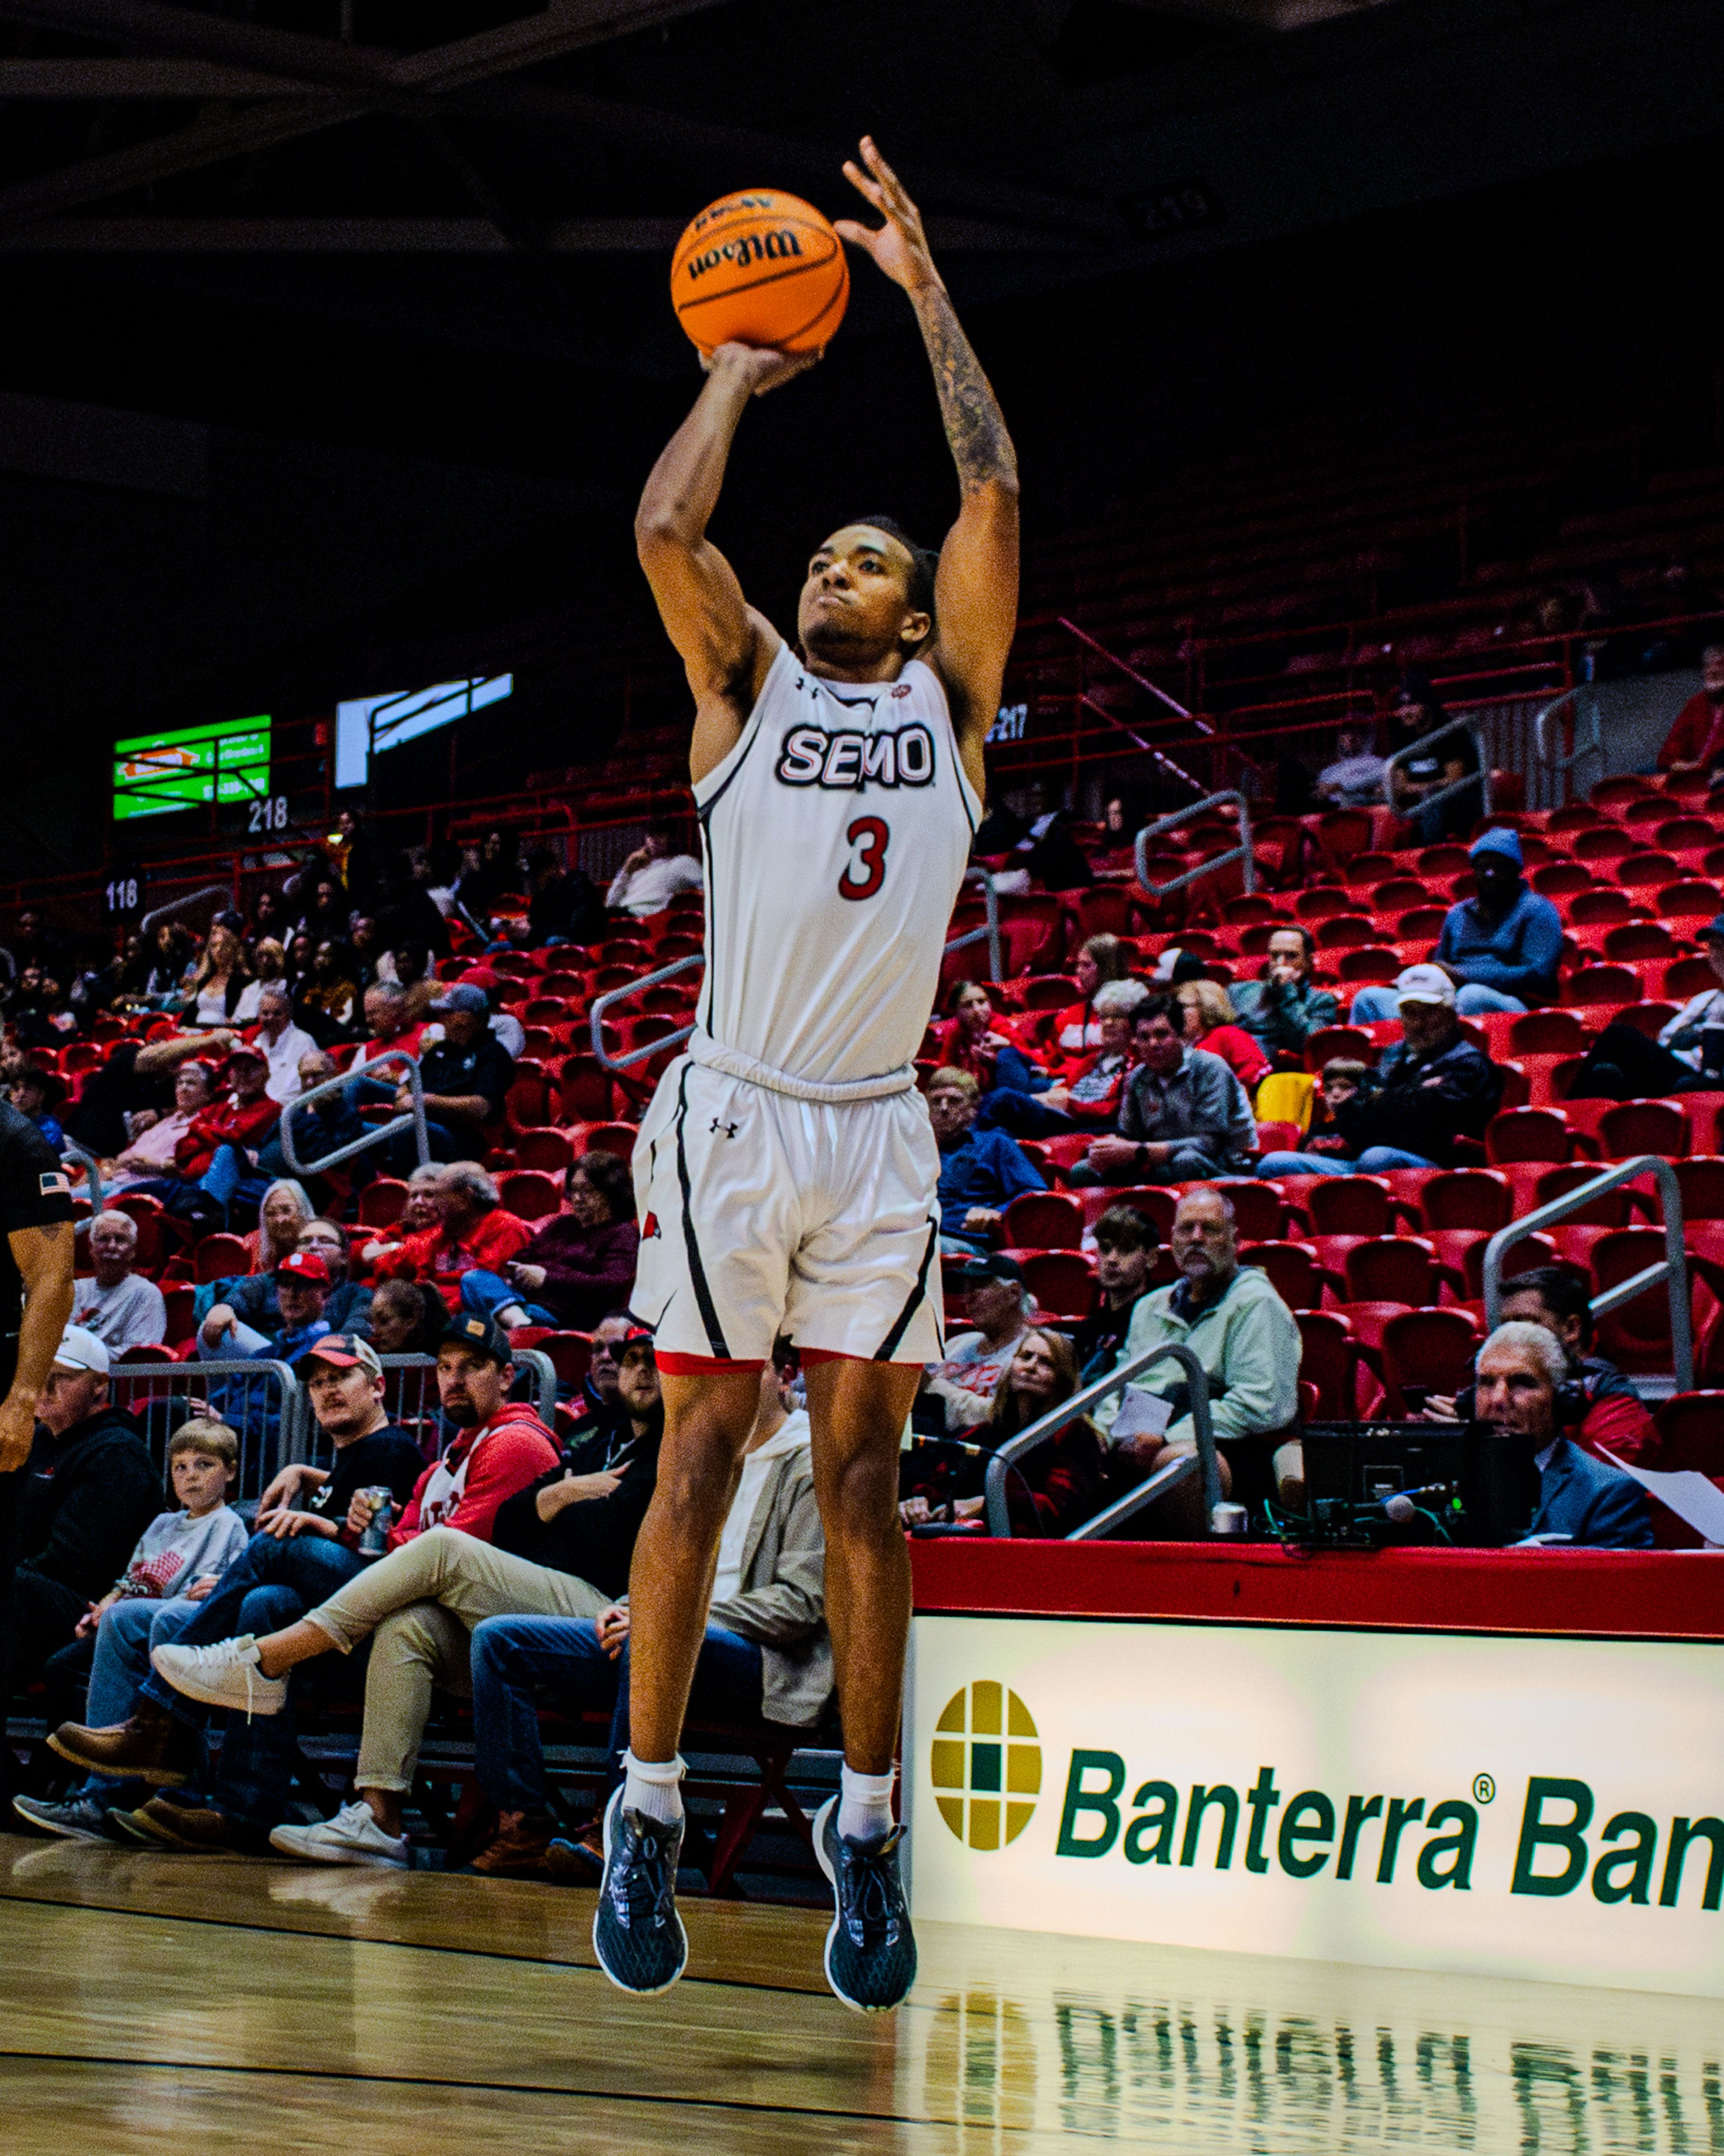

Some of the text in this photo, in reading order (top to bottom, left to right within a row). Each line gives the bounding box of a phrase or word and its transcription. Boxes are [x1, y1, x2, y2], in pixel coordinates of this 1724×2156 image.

[687, 229, 803, 279] Wilson
[775, 722, 935, 791] SEMO
[247, 795, 288, 833] 218
[838, 814, 890, 901] 3
[106, 878, 137, 912] 118
